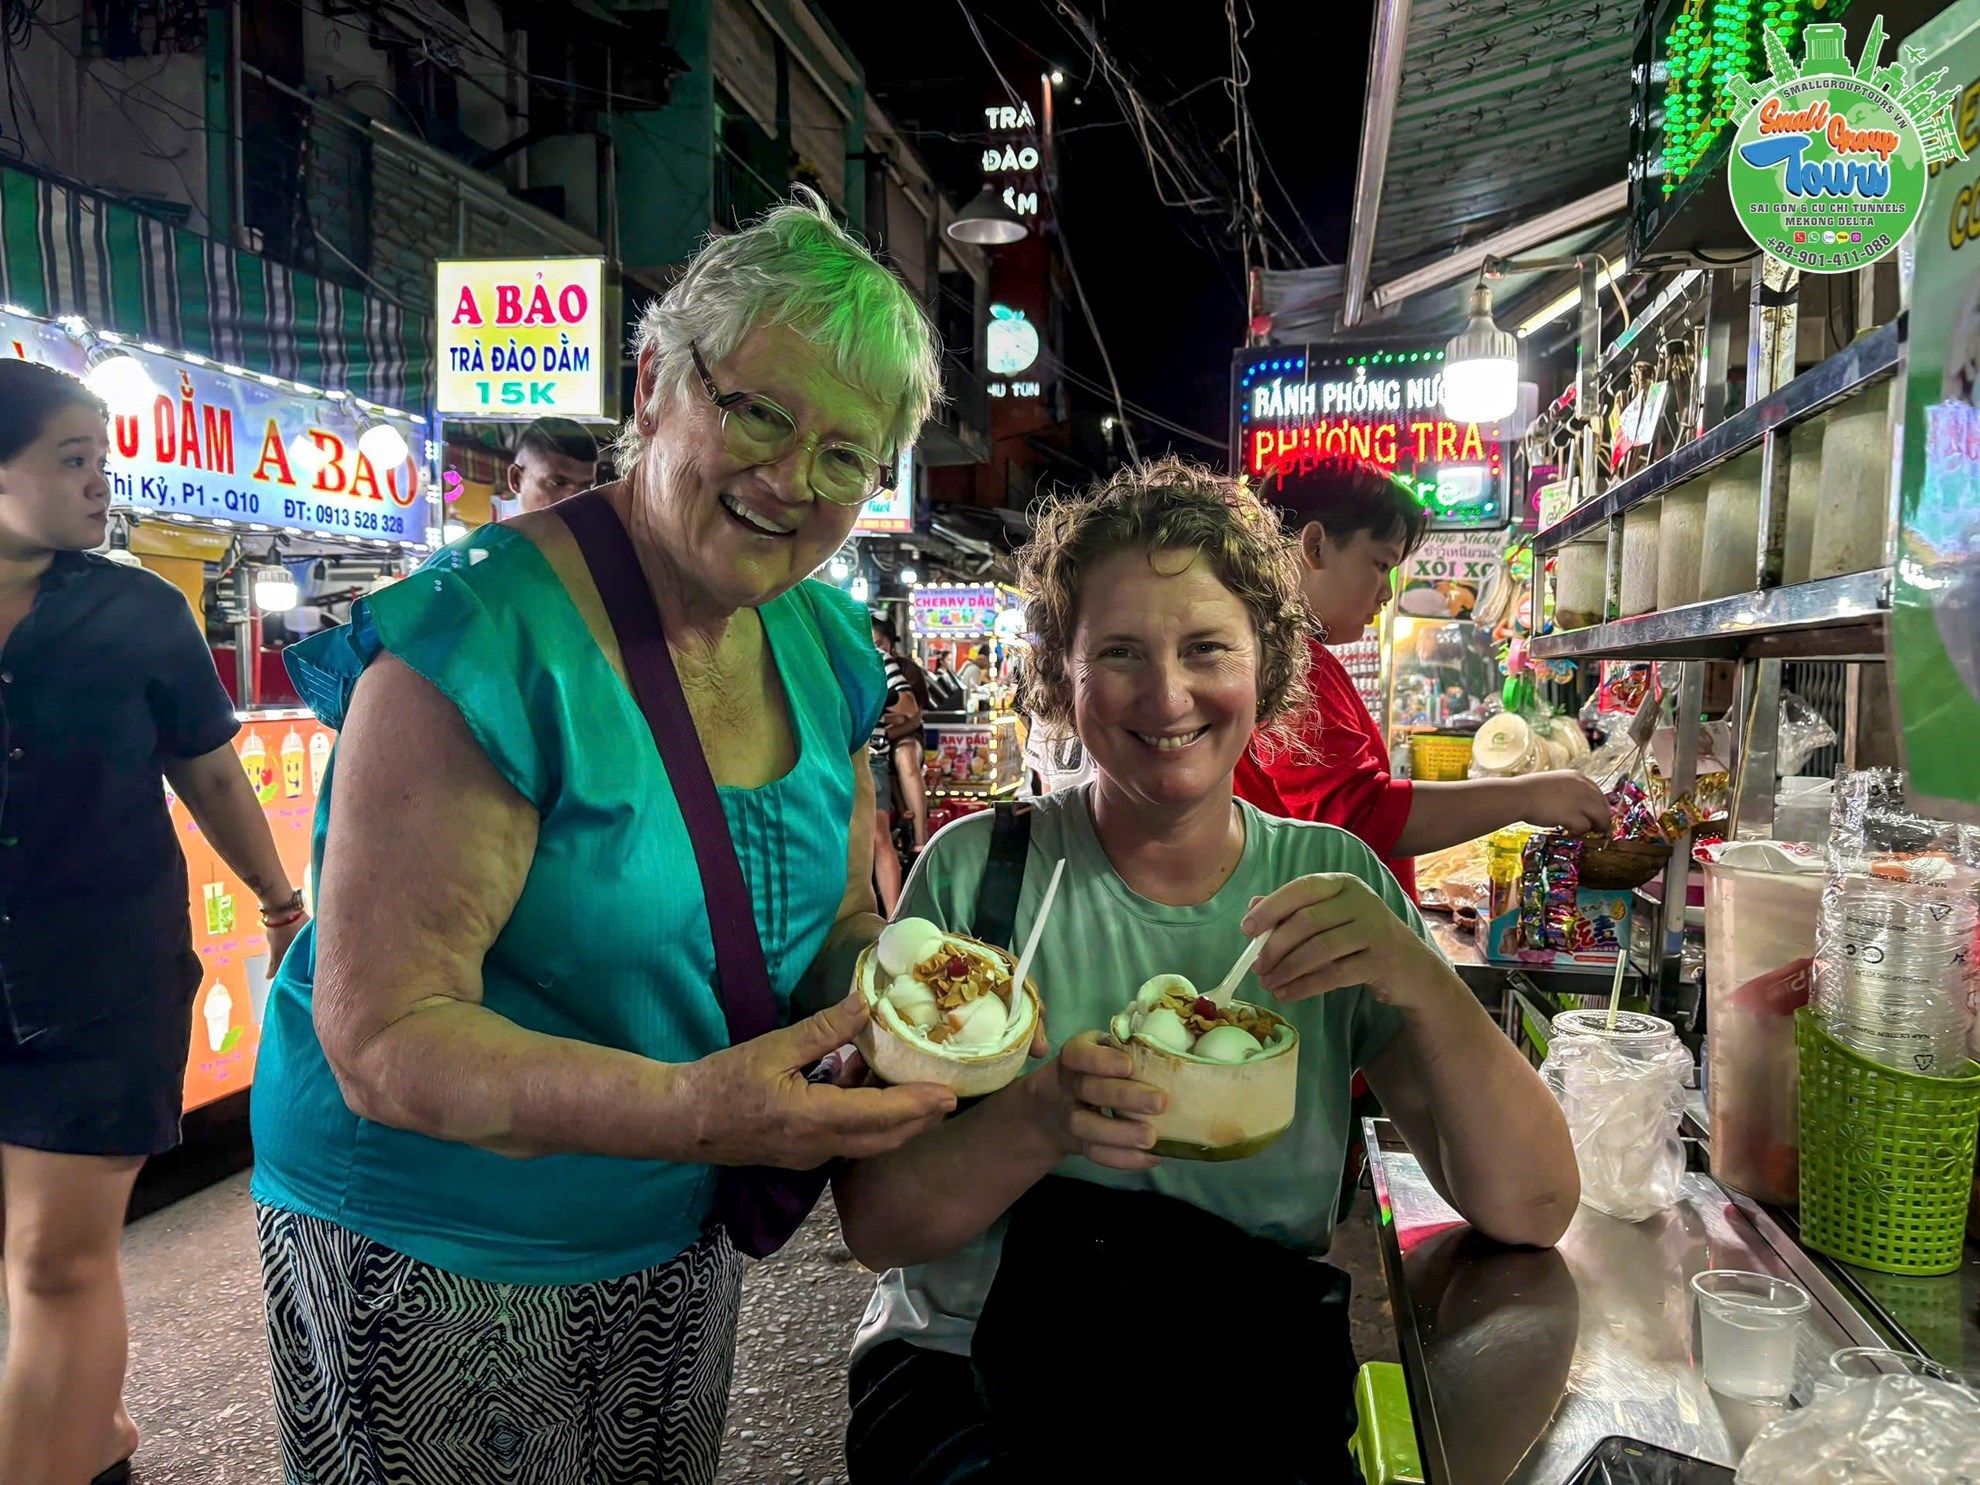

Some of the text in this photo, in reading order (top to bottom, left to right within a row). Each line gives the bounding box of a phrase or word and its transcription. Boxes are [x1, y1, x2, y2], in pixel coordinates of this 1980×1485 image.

[451, 271, 588, 324] A BẢO
[450, 332, 589, 372] TRÀ ĐÀO DẰM
[476, 381, 556, 404] 15K
[253, 418, 296, 487] A
[183, 482, 204, 506] P1
[225, 489, 259, 514] Q10
[284, 499, 311, 521] ĐT:
[316, 504, 349, 527] 0913
[354, 510, 378, 531] 528
[381, 514, 404, 534] 328
[1414, 556, 1456, 577] XÔI
[915, 597, 965, 608] CHERRY
